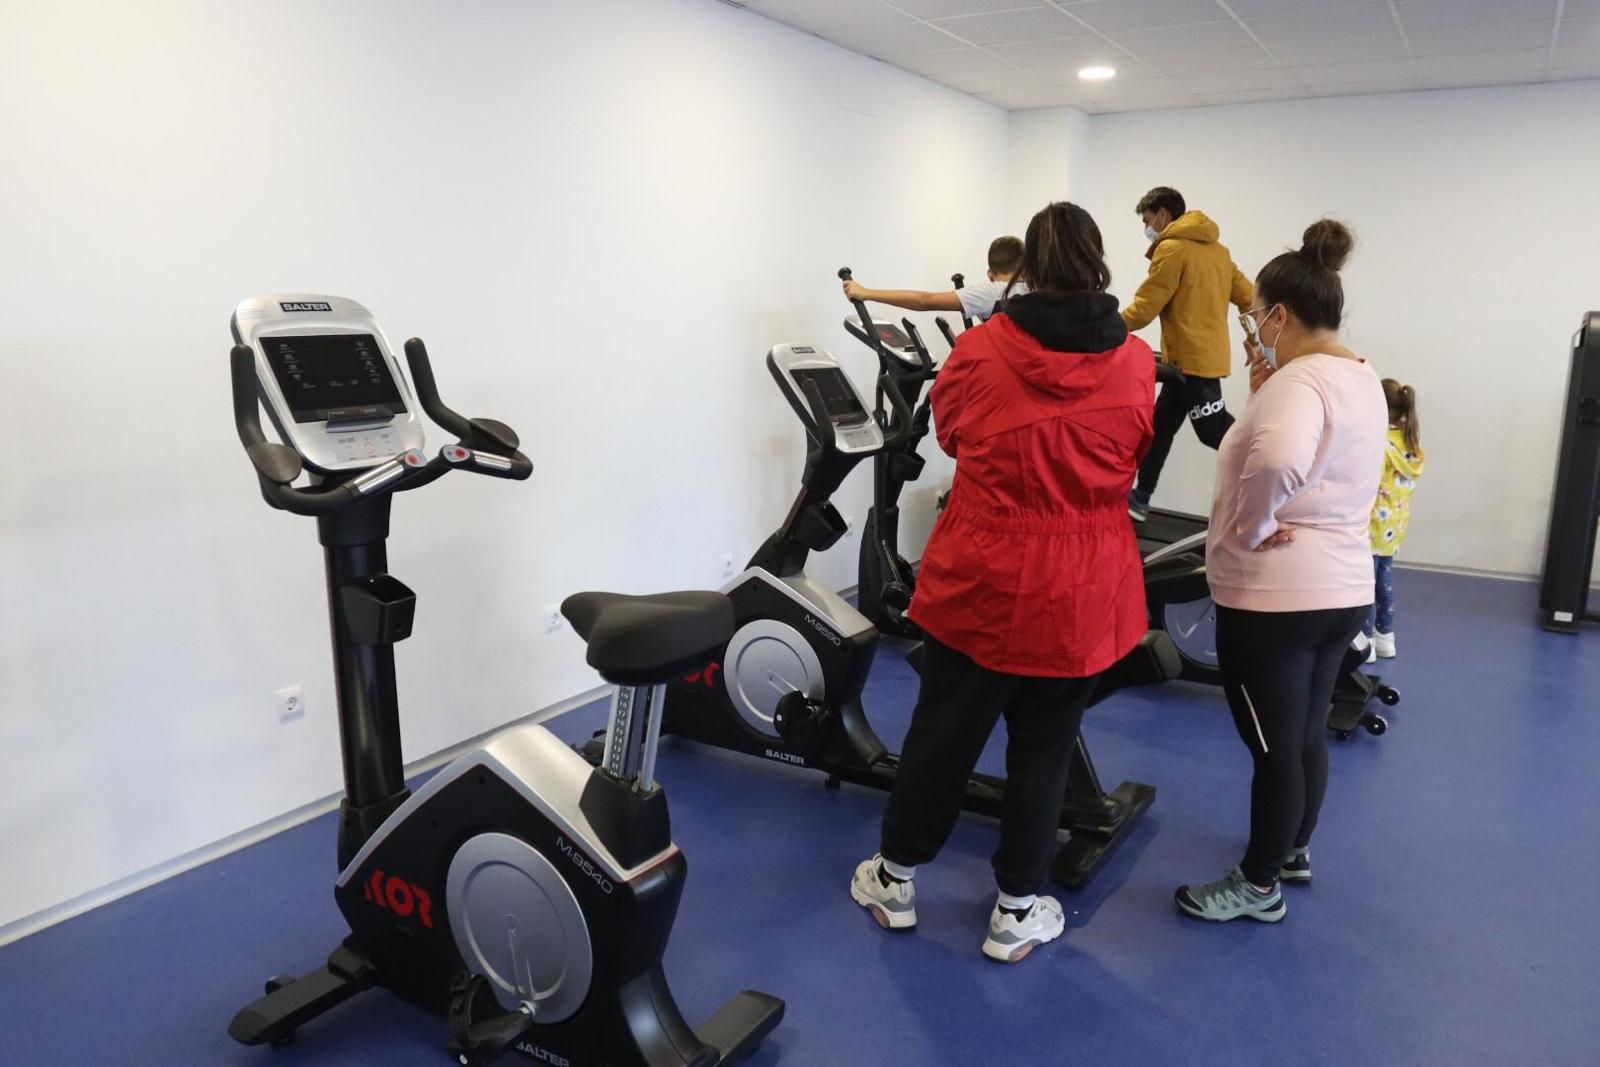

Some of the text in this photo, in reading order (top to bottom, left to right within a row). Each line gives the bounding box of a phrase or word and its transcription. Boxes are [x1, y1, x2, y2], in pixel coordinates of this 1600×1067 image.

[282, 303, 330, 311] SALTER
[1189, 399, 1225, 420] didas
[765, 749, 804, 765] SALTER
